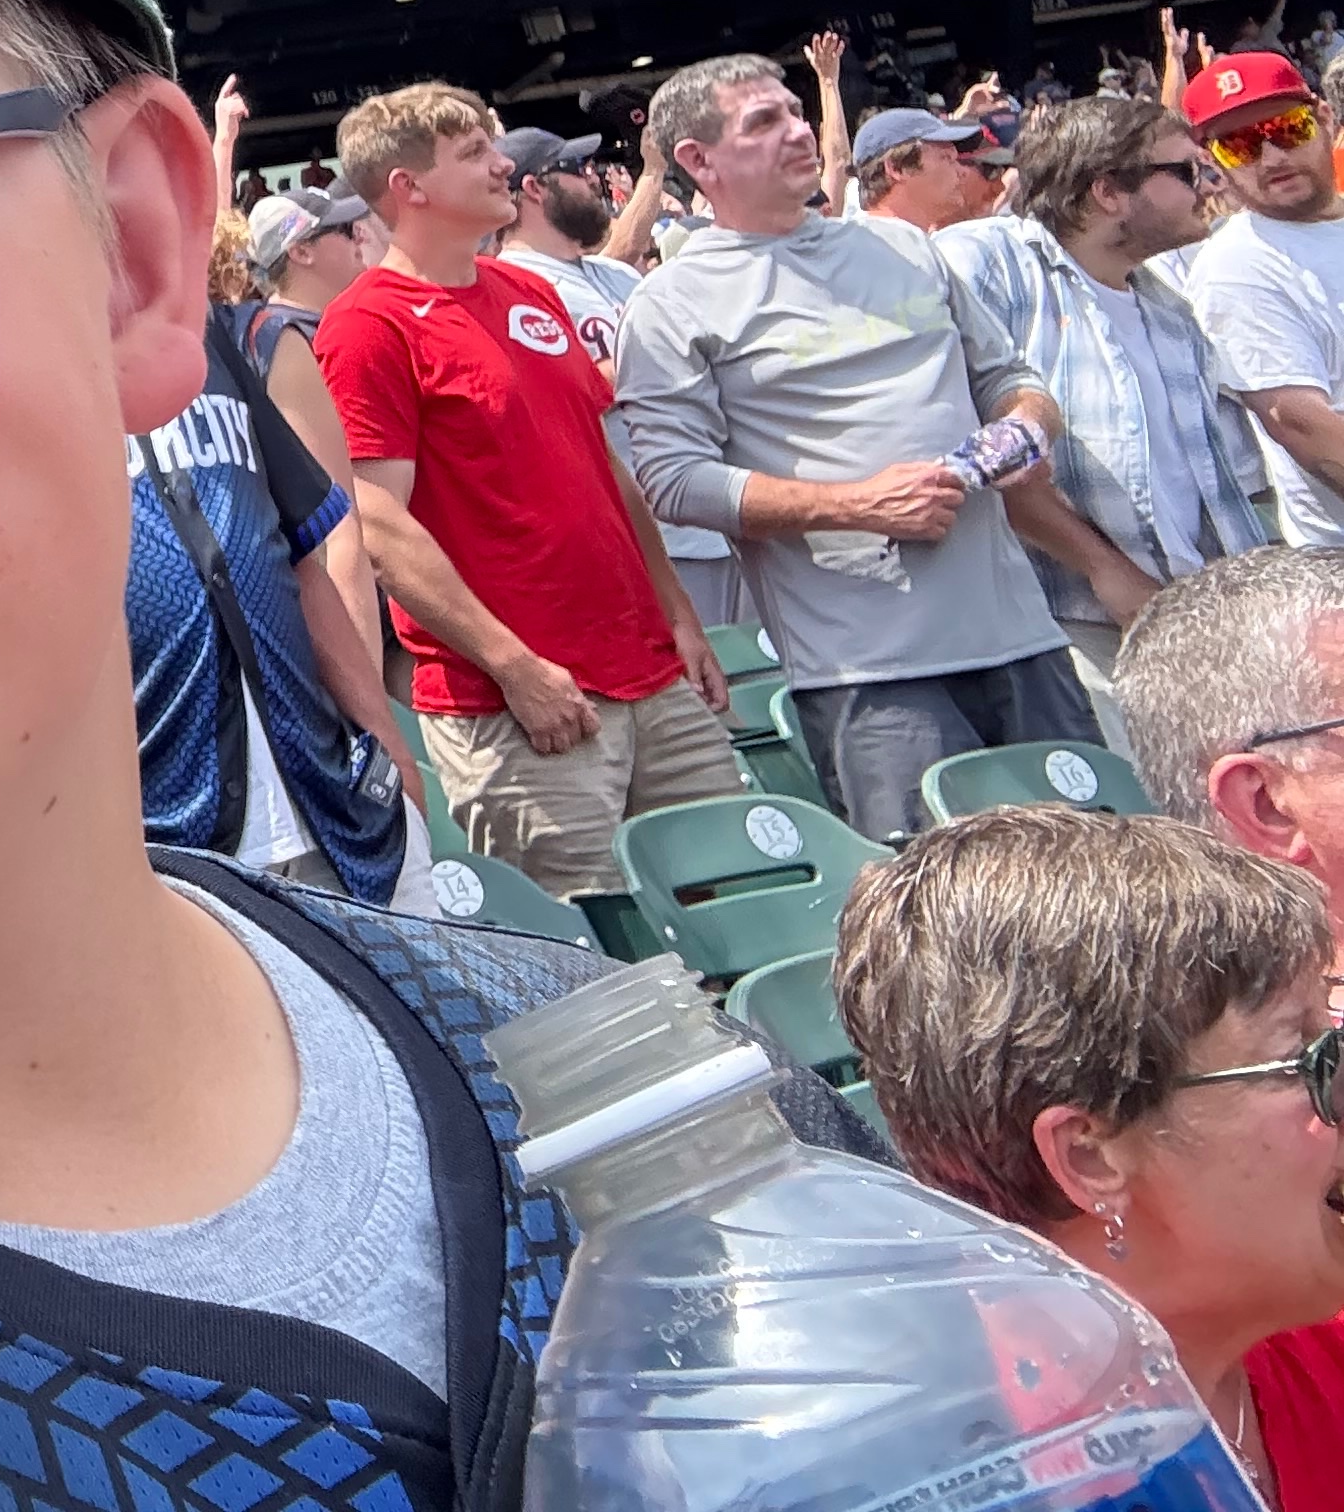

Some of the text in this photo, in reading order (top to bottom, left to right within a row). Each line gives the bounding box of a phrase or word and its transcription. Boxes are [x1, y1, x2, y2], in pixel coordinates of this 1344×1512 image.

[1058, 765, 1085, 788] 16
[759, 819, 786, 844] 15
[443, 875, 470, 900] 14
